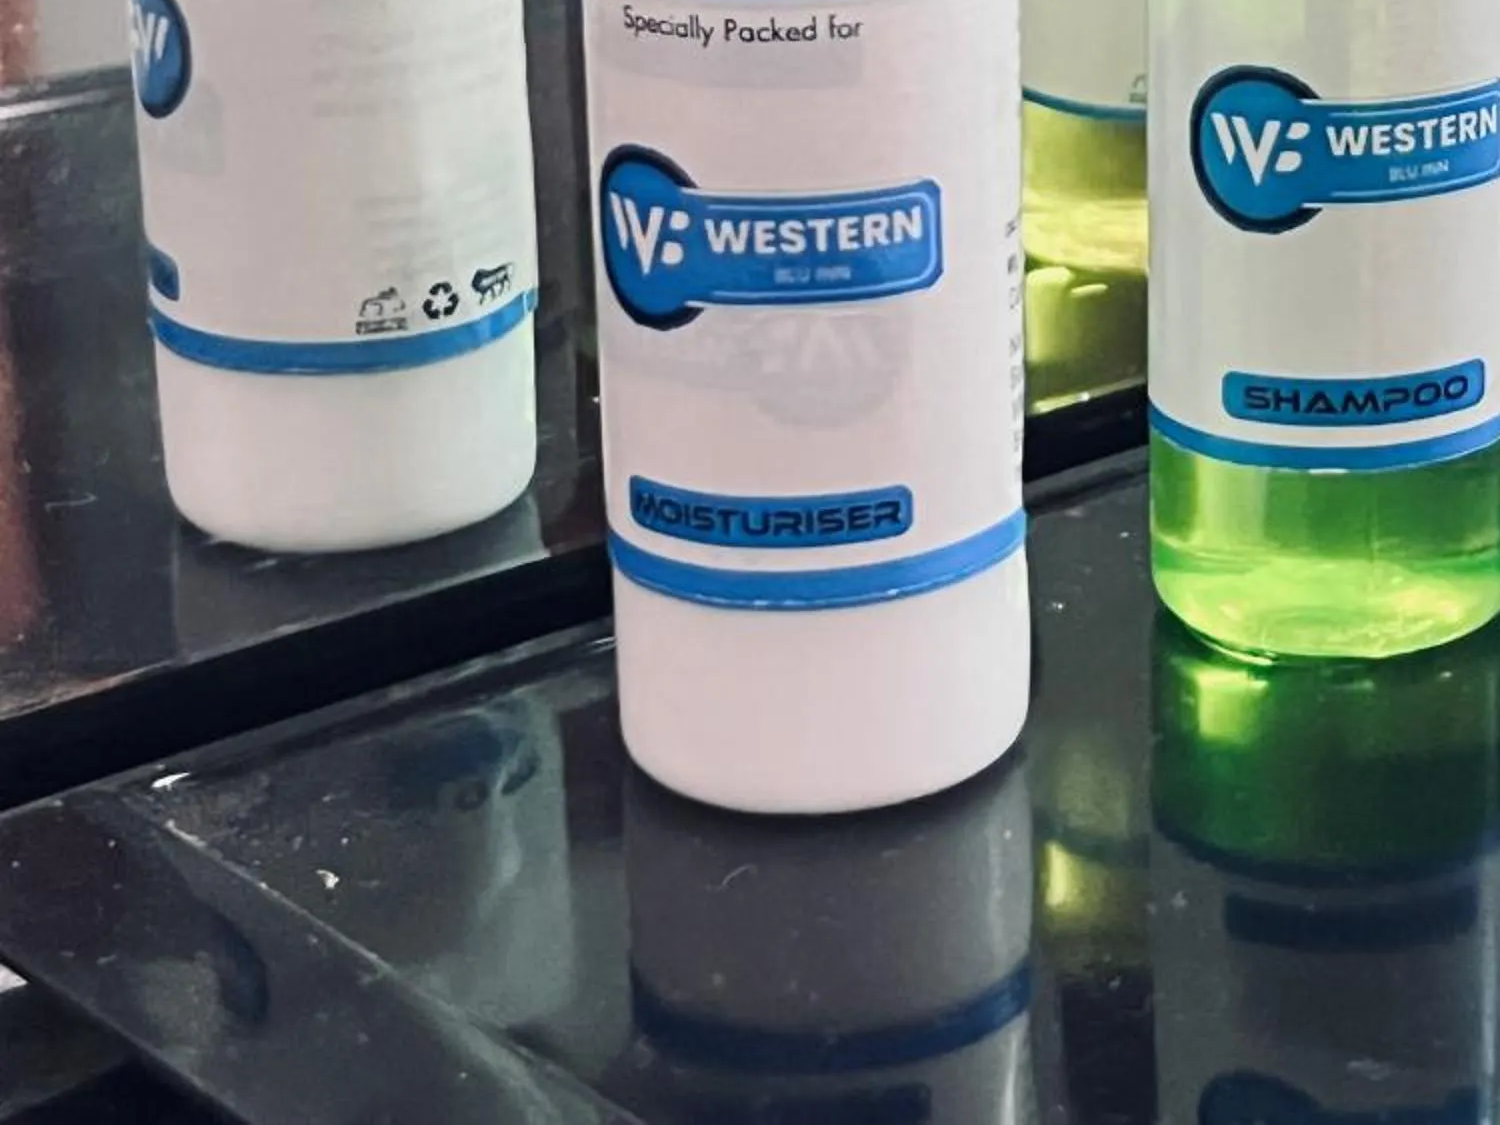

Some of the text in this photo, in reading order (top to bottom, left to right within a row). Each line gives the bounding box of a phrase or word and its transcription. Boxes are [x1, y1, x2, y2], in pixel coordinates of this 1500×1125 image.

[622, 4, 864, 49] Specially Packed for
[1325, 103, 1499, 157] WESTERN
[703, 204, 923, 255] WESTERN
[1243, 374, 1469, 415] SHAMPOO
[634, 490, 902, 538] MOISTURISER
